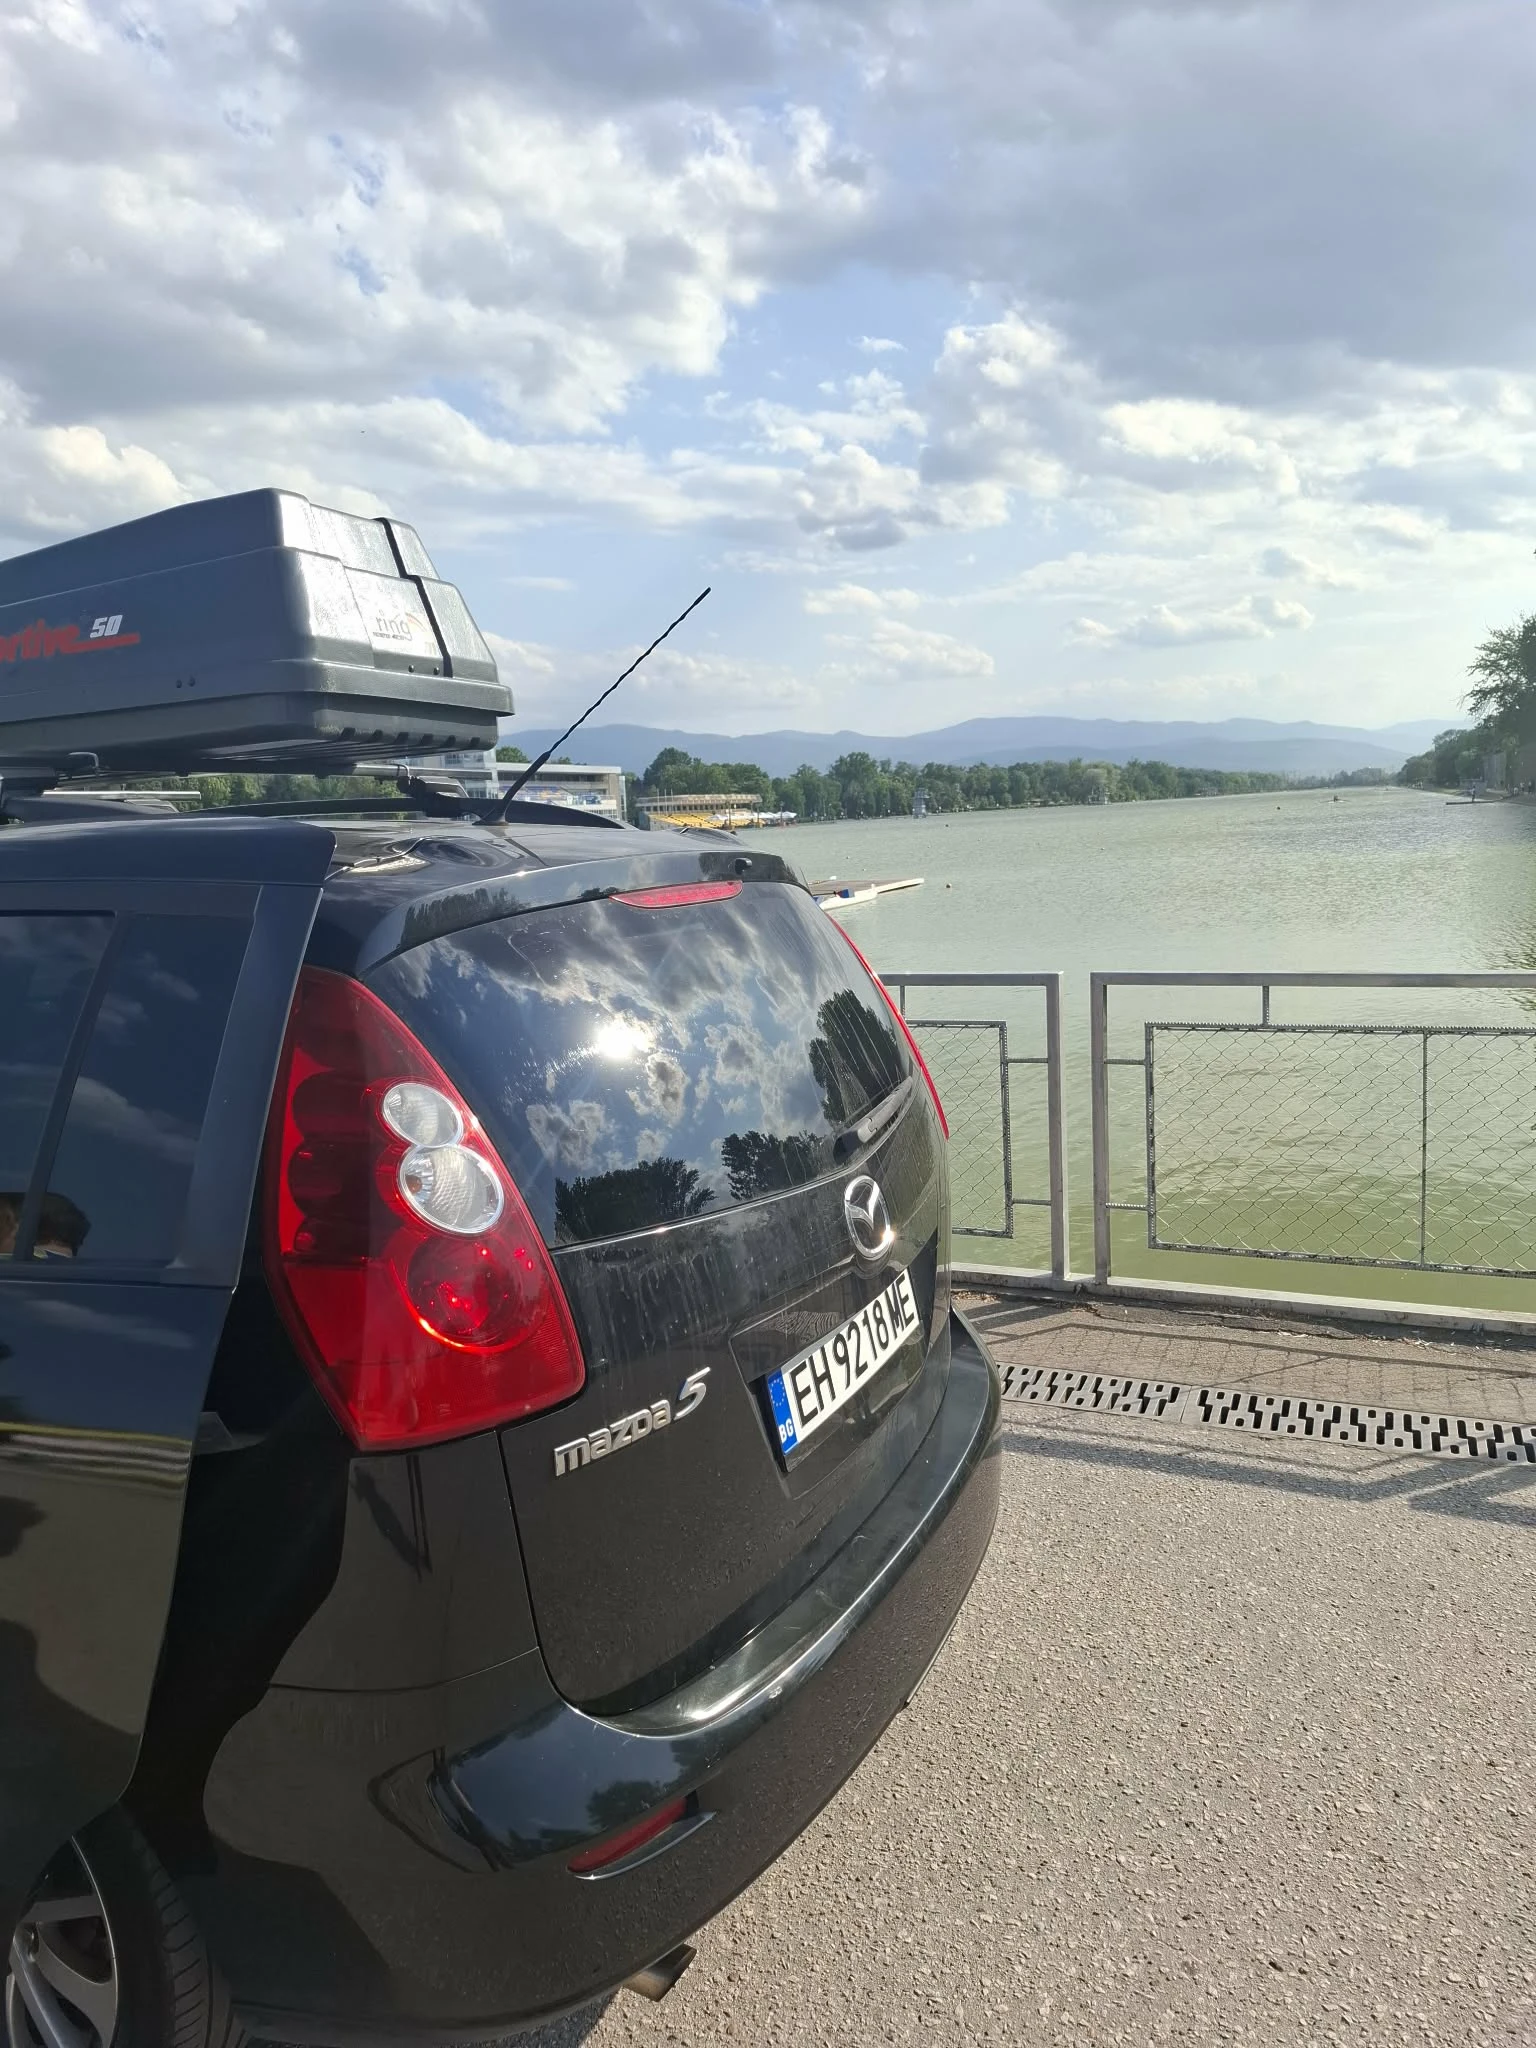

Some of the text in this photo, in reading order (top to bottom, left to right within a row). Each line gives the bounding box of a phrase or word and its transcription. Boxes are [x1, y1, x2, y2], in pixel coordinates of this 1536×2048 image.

[89, 614, 123, 638] 50
[789, 1274, 915, 1428] EH 9218 ME
[778, 1418, 795, 1443] BG
